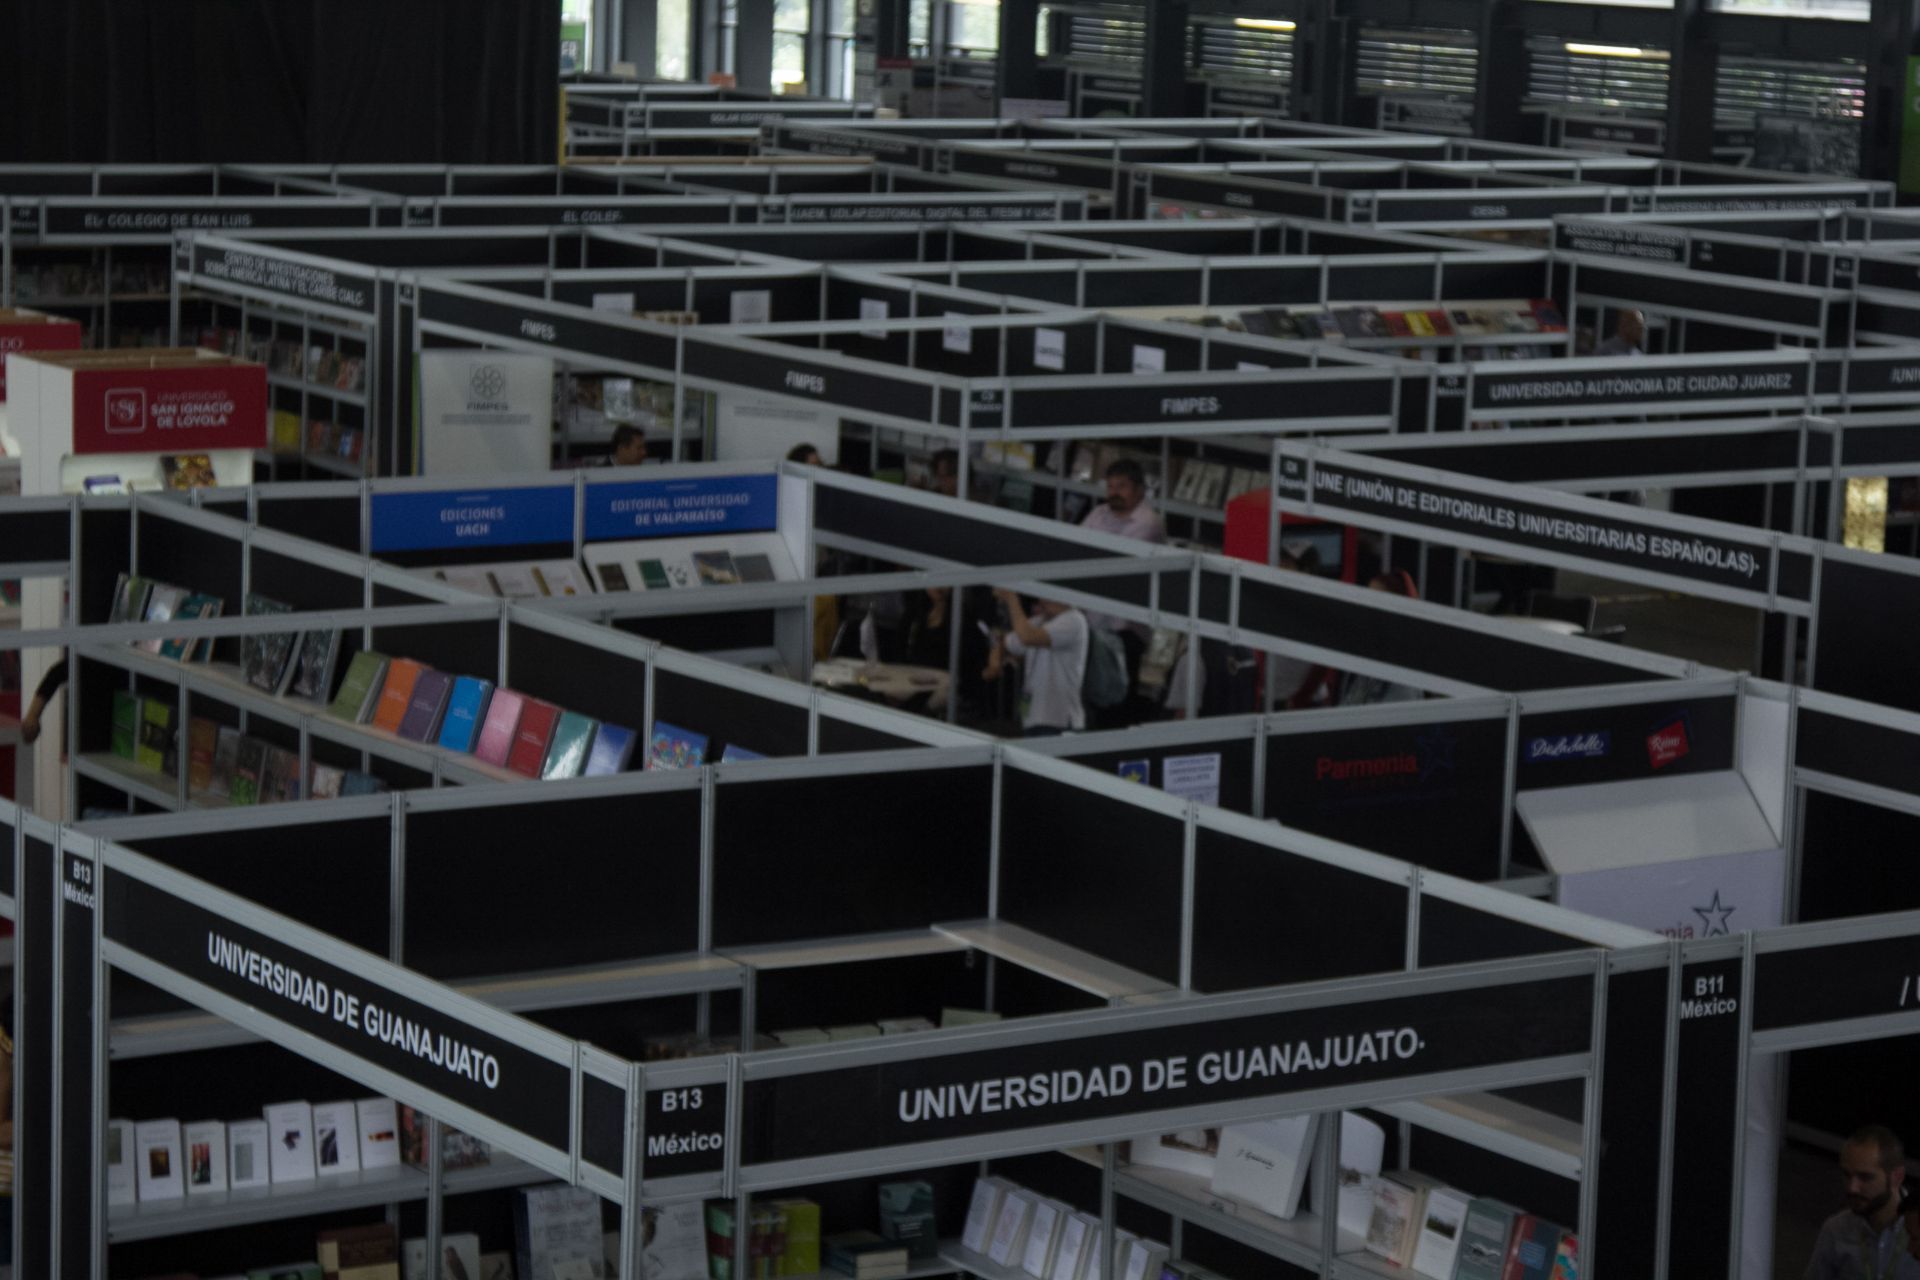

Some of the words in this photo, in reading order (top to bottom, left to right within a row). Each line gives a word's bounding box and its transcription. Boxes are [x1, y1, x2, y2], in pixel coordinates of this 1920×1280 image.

[107, 213, 167, 228] COLEGIO
[170, 213, 188, 227] DE
[192, 213, 218, 227] SAN
[222, 212, 251, 227] LUIS
[157, 390, 228, 401] UNIVERSIDAD
[1488, 379, 1583, 401] UNIVERSIDAD
[1665, 377, 1684, 394] DE
[1686, 374, 1738, 393] CIUDAD
[150, 402, 178, 417] SAN
[180, 400, 235, 415] IGNACIO
[157, 415, 175, 429] DE
[177, 413, 229, 428] LOYOLA
[611, 497, 669, 513] EDITORIAL
[673, 493, 750, 508] UNIVERSIDAD
[1314, 471, 1344, 493] UNE
[1345, 476, 1394, 504] (UNIÓN
[1397, 488, 1416, 509] DE
[1421, 492, 1515, 530] EDITORIALES
[1519, 514, 1646, 553] UNIVERSITARIAS
[440, 506, 505, 523] EDICIONES
[635, 512, 651, 526] DE
[455, 523, 490, 537] UACH
[73, 861, 92, 885] B13
[64, 880, 95, 909] México
[1695, 975, 1725, 996] B11
[208, 931, 329, 1014] UNIVERSIDAD
[333, 991, 359, 1030] DE
[364, 1003, 500, 1090] GUANAJUATO
[1680, 996, 1737, 1019] México
[661, 1088, 703, 1113] B13
[898, 1064, 1134, 1124] UNIVERSIDAD
[1142, 1057, 1188, 1093] DE
[648, 1130, 724, 1158] México
